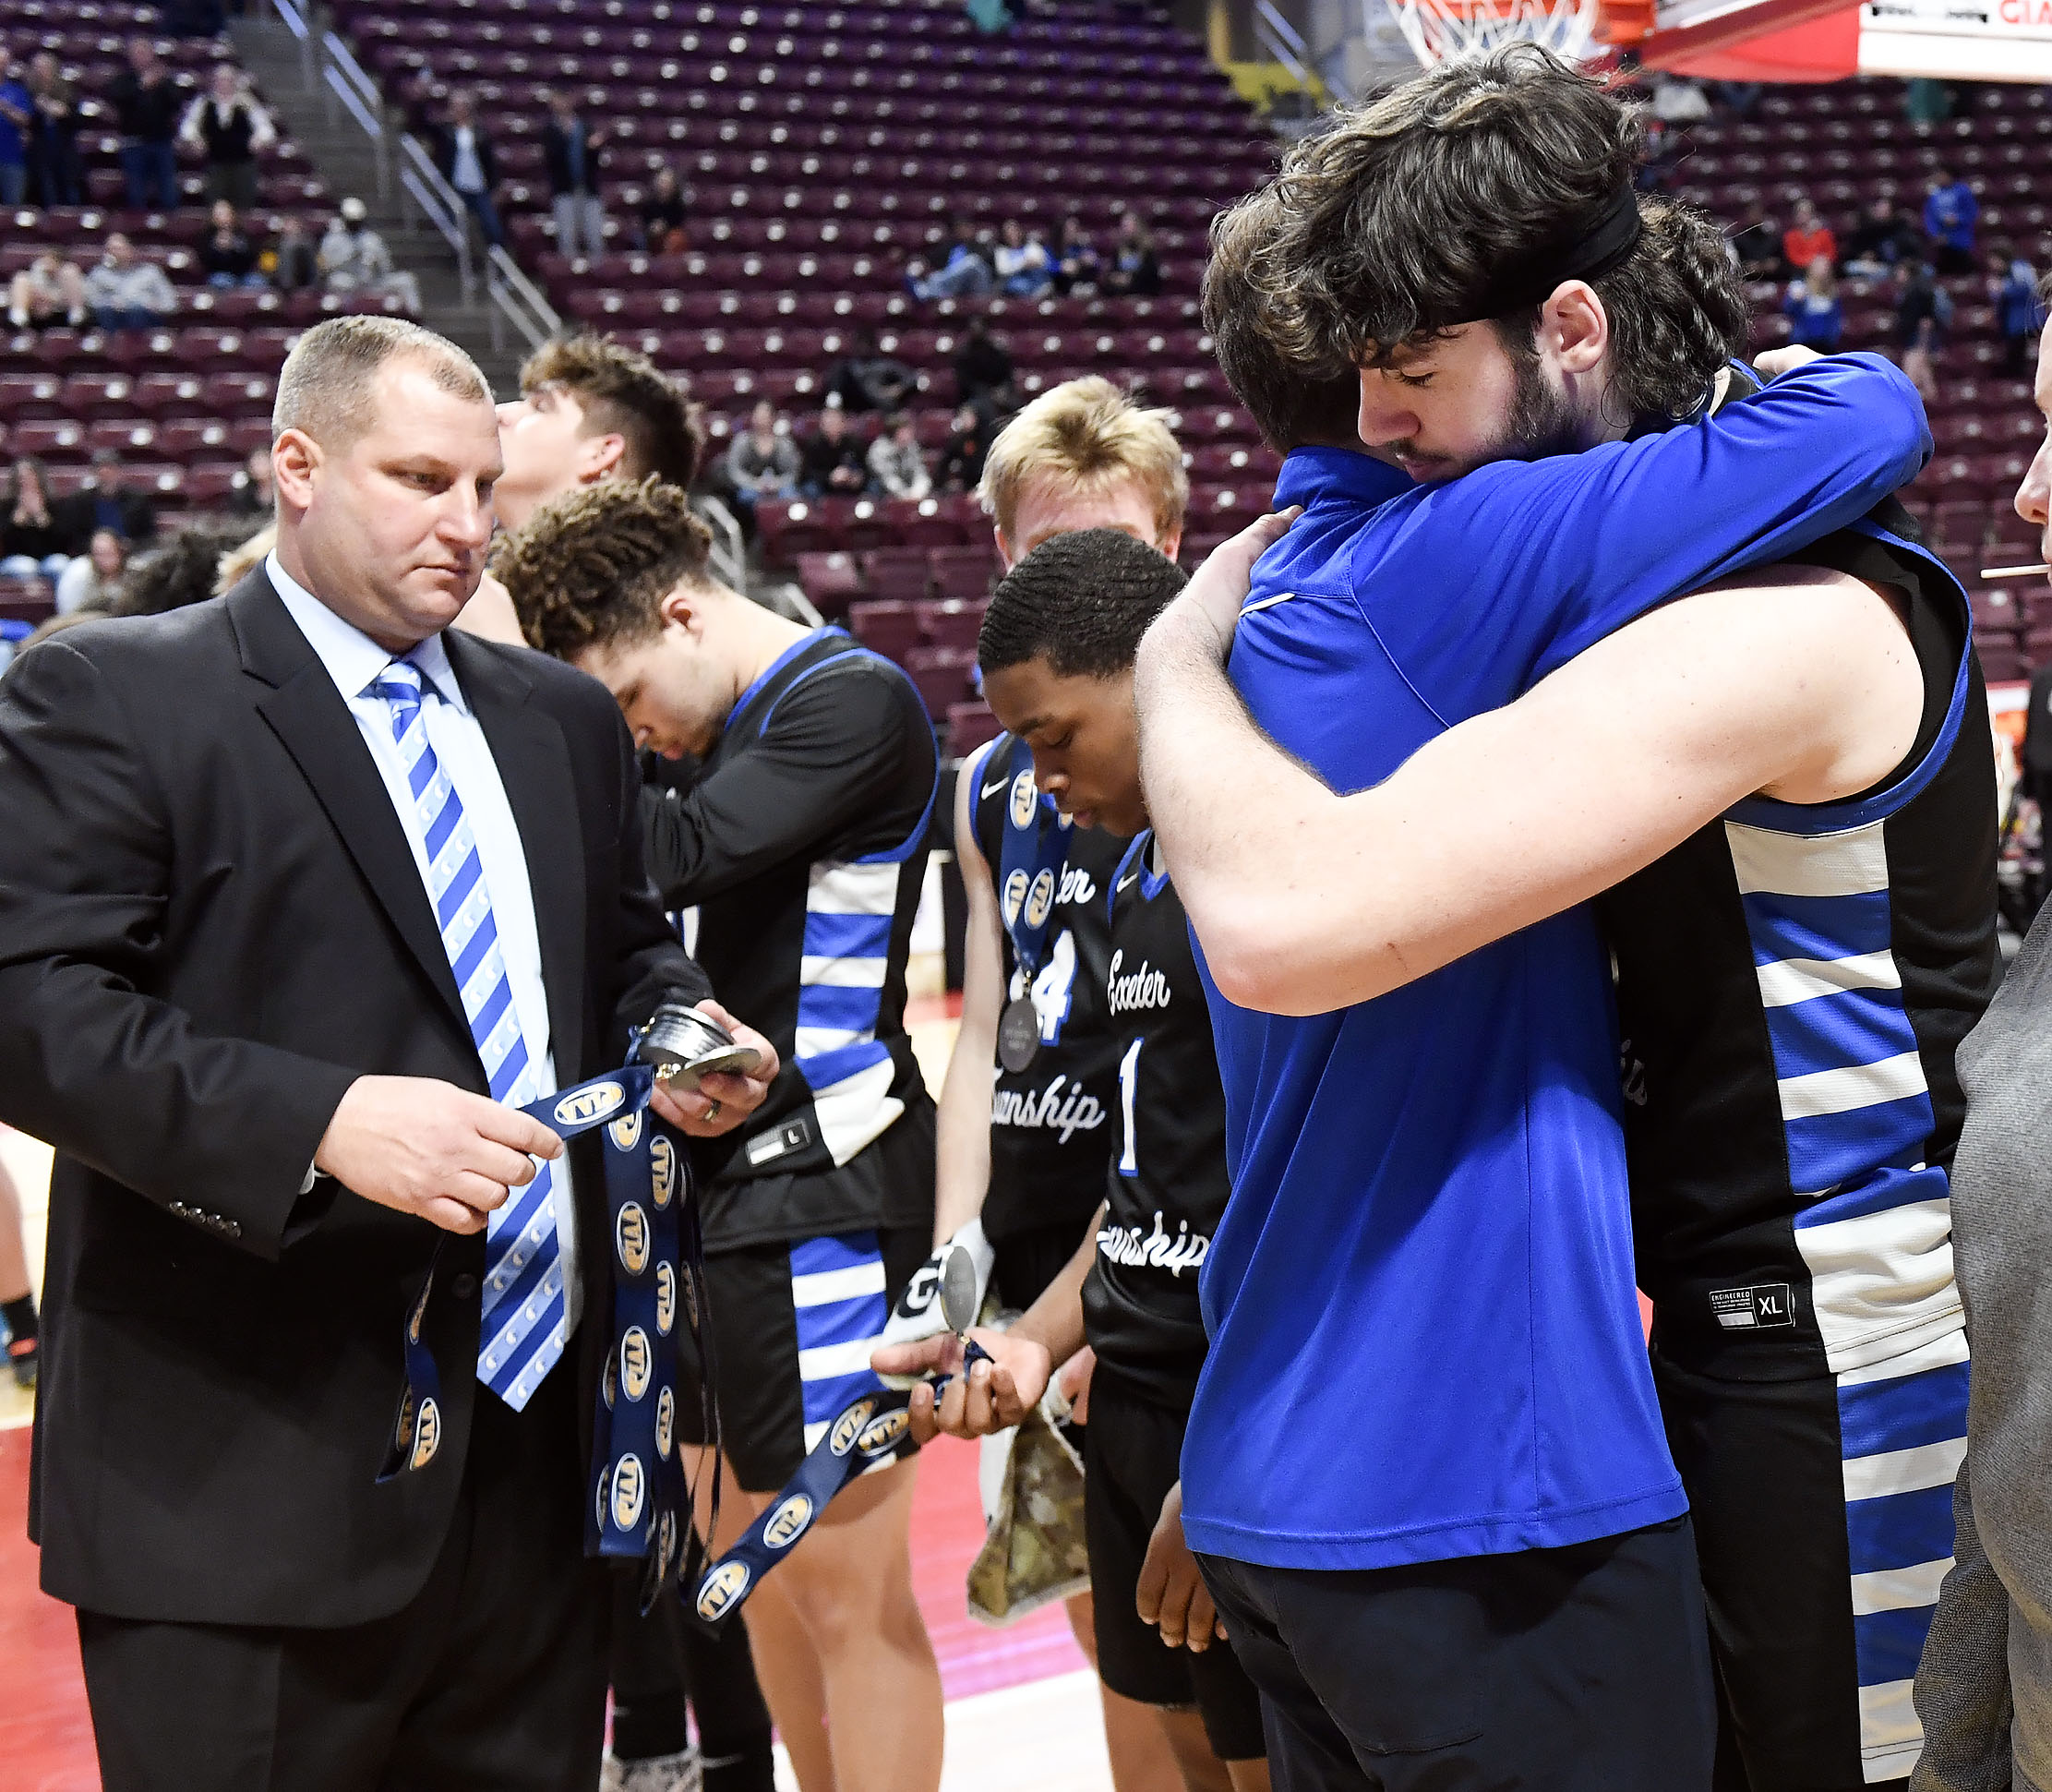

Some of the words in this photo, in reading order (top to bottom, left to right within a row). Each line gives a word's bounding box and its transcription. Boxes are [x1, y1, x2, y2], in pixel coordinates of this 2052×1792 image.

[1055, 860, 1097, 904] ter
[1108, 948, 1171, 1016] Exeter
[1118, 1036, 1145, 1177] 1
[787, 1128, 800, 1145] L
[1758, 1295, 1783, 1316] XL
